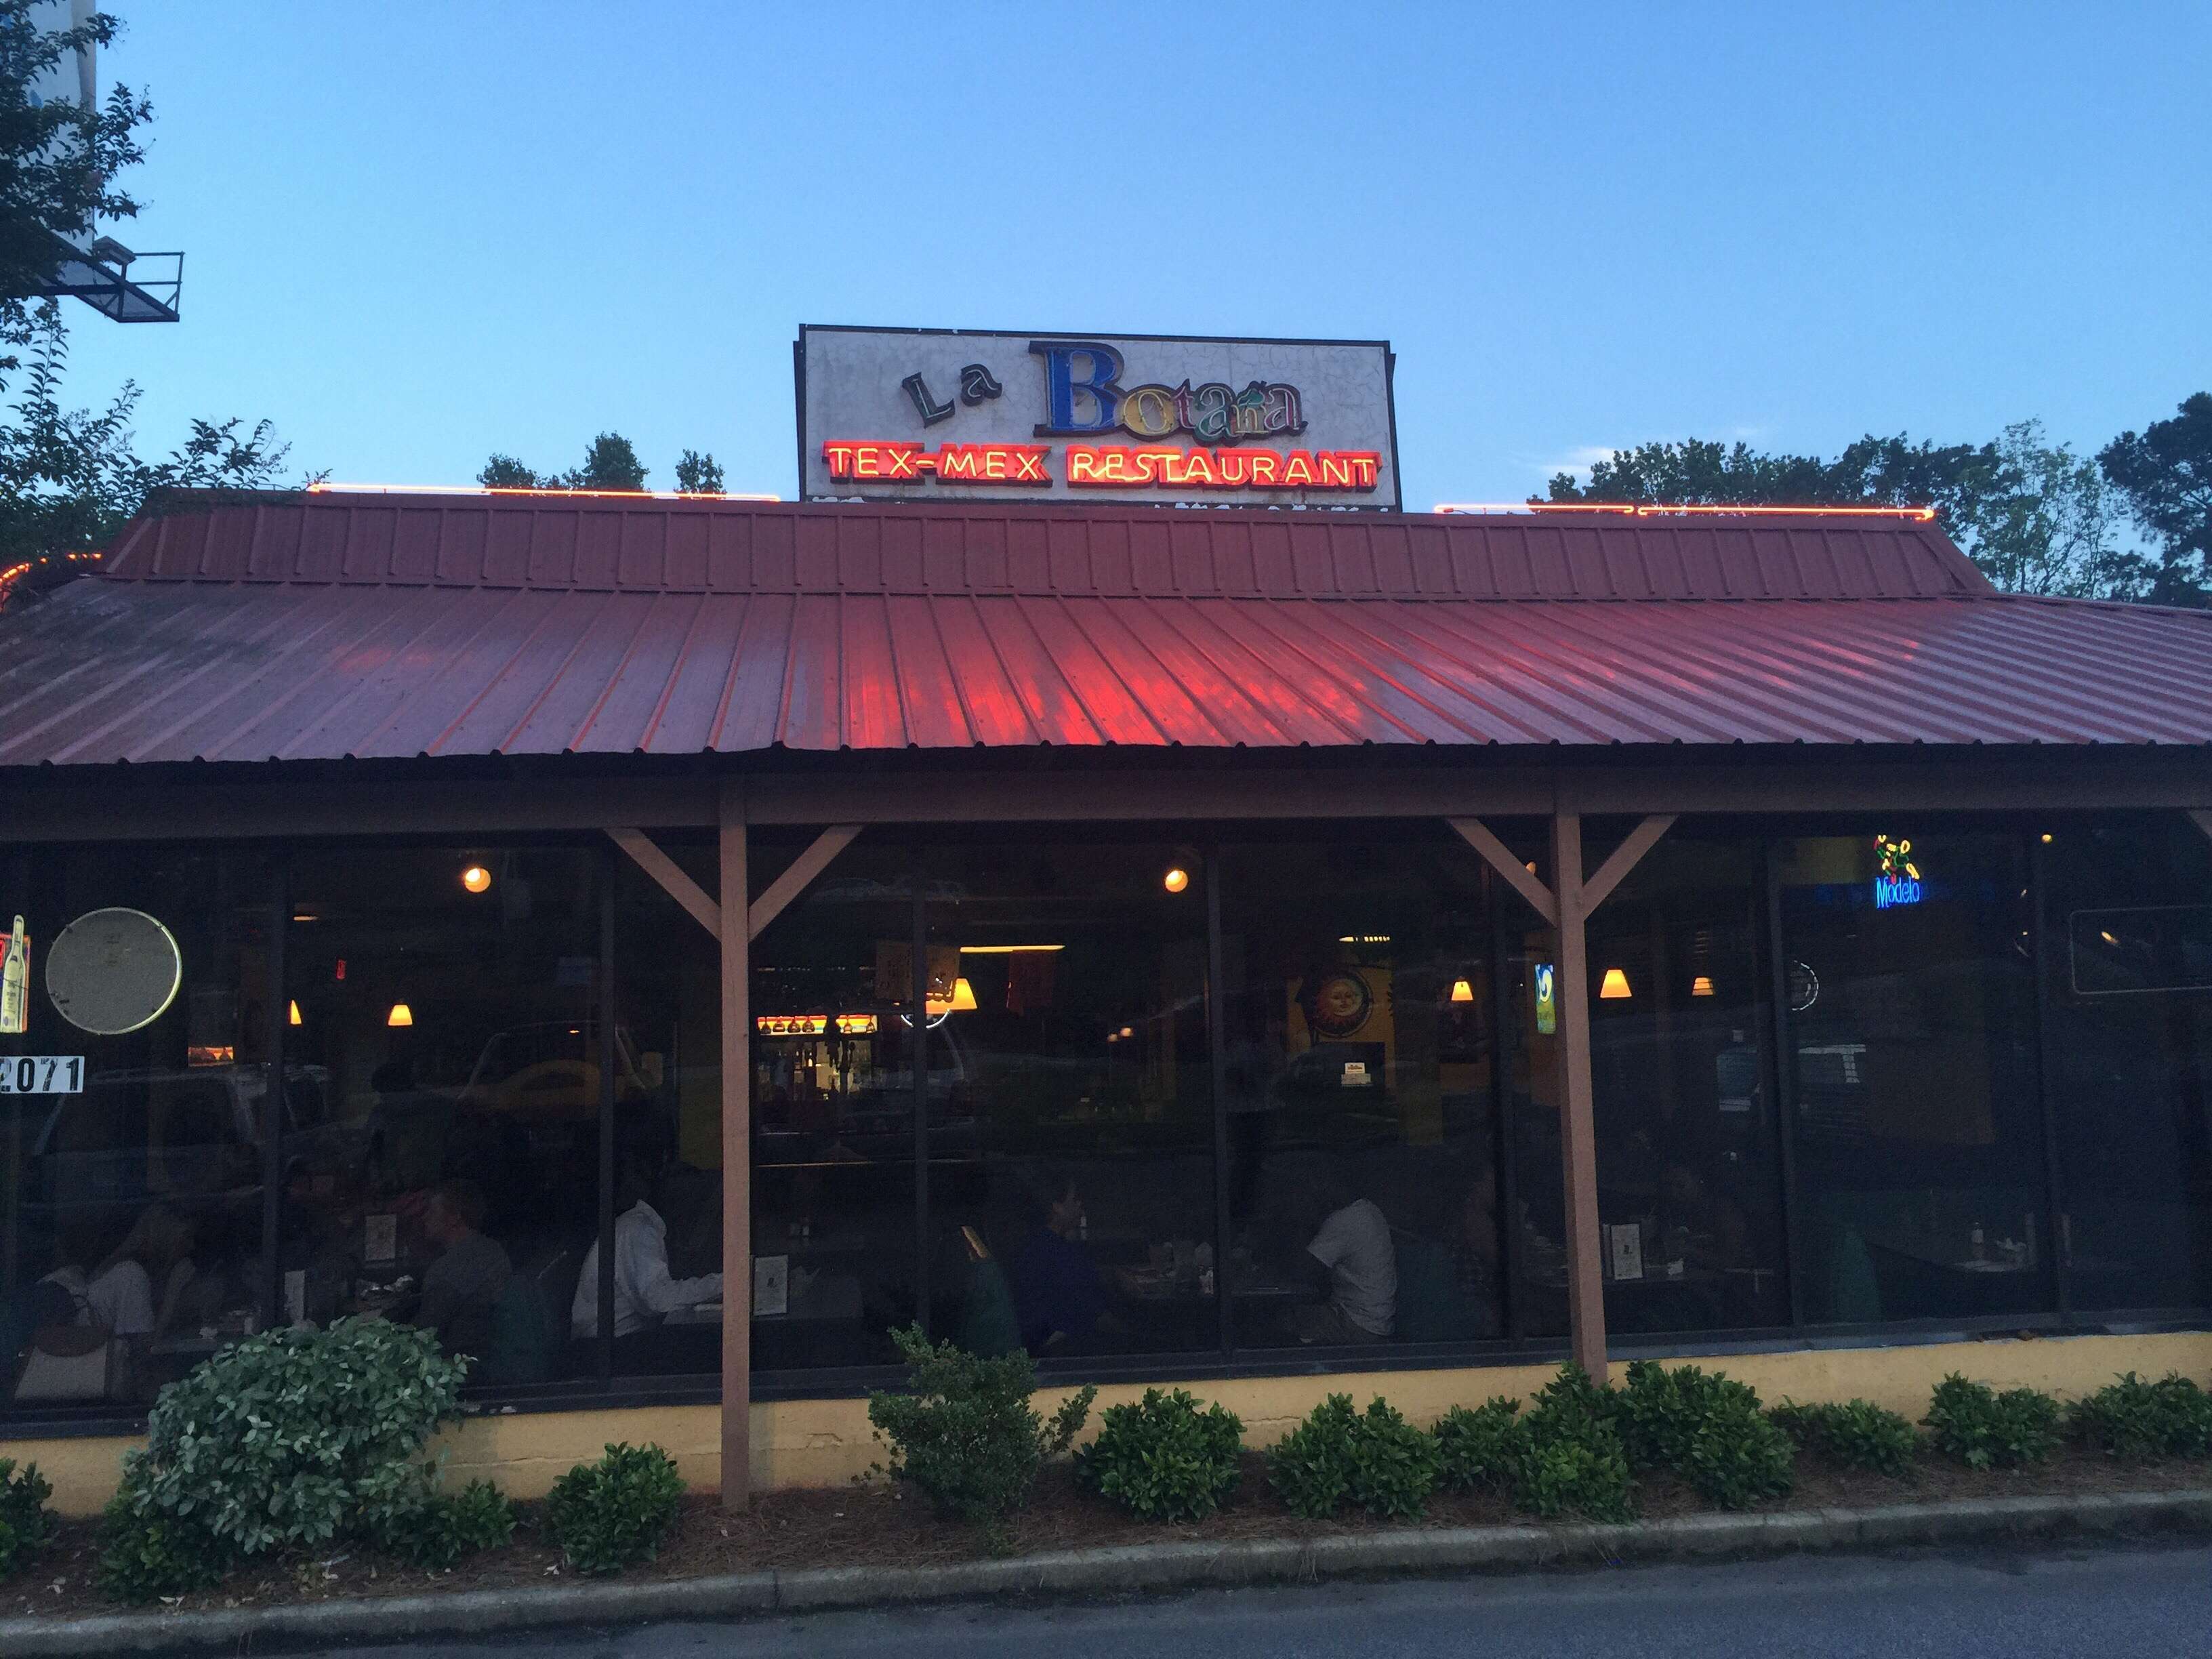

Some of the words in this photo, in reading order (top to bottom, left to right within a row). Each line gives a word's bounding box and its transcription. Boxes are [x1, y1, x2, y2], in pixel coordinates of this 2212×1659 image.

[902, 364, 1003, 428] La
[822, 441, 1053, 488] TEX-MEX
[1066, 445, 1382, 493] RESTAURANT
[1876, 876, 1920, 908] Modelo
